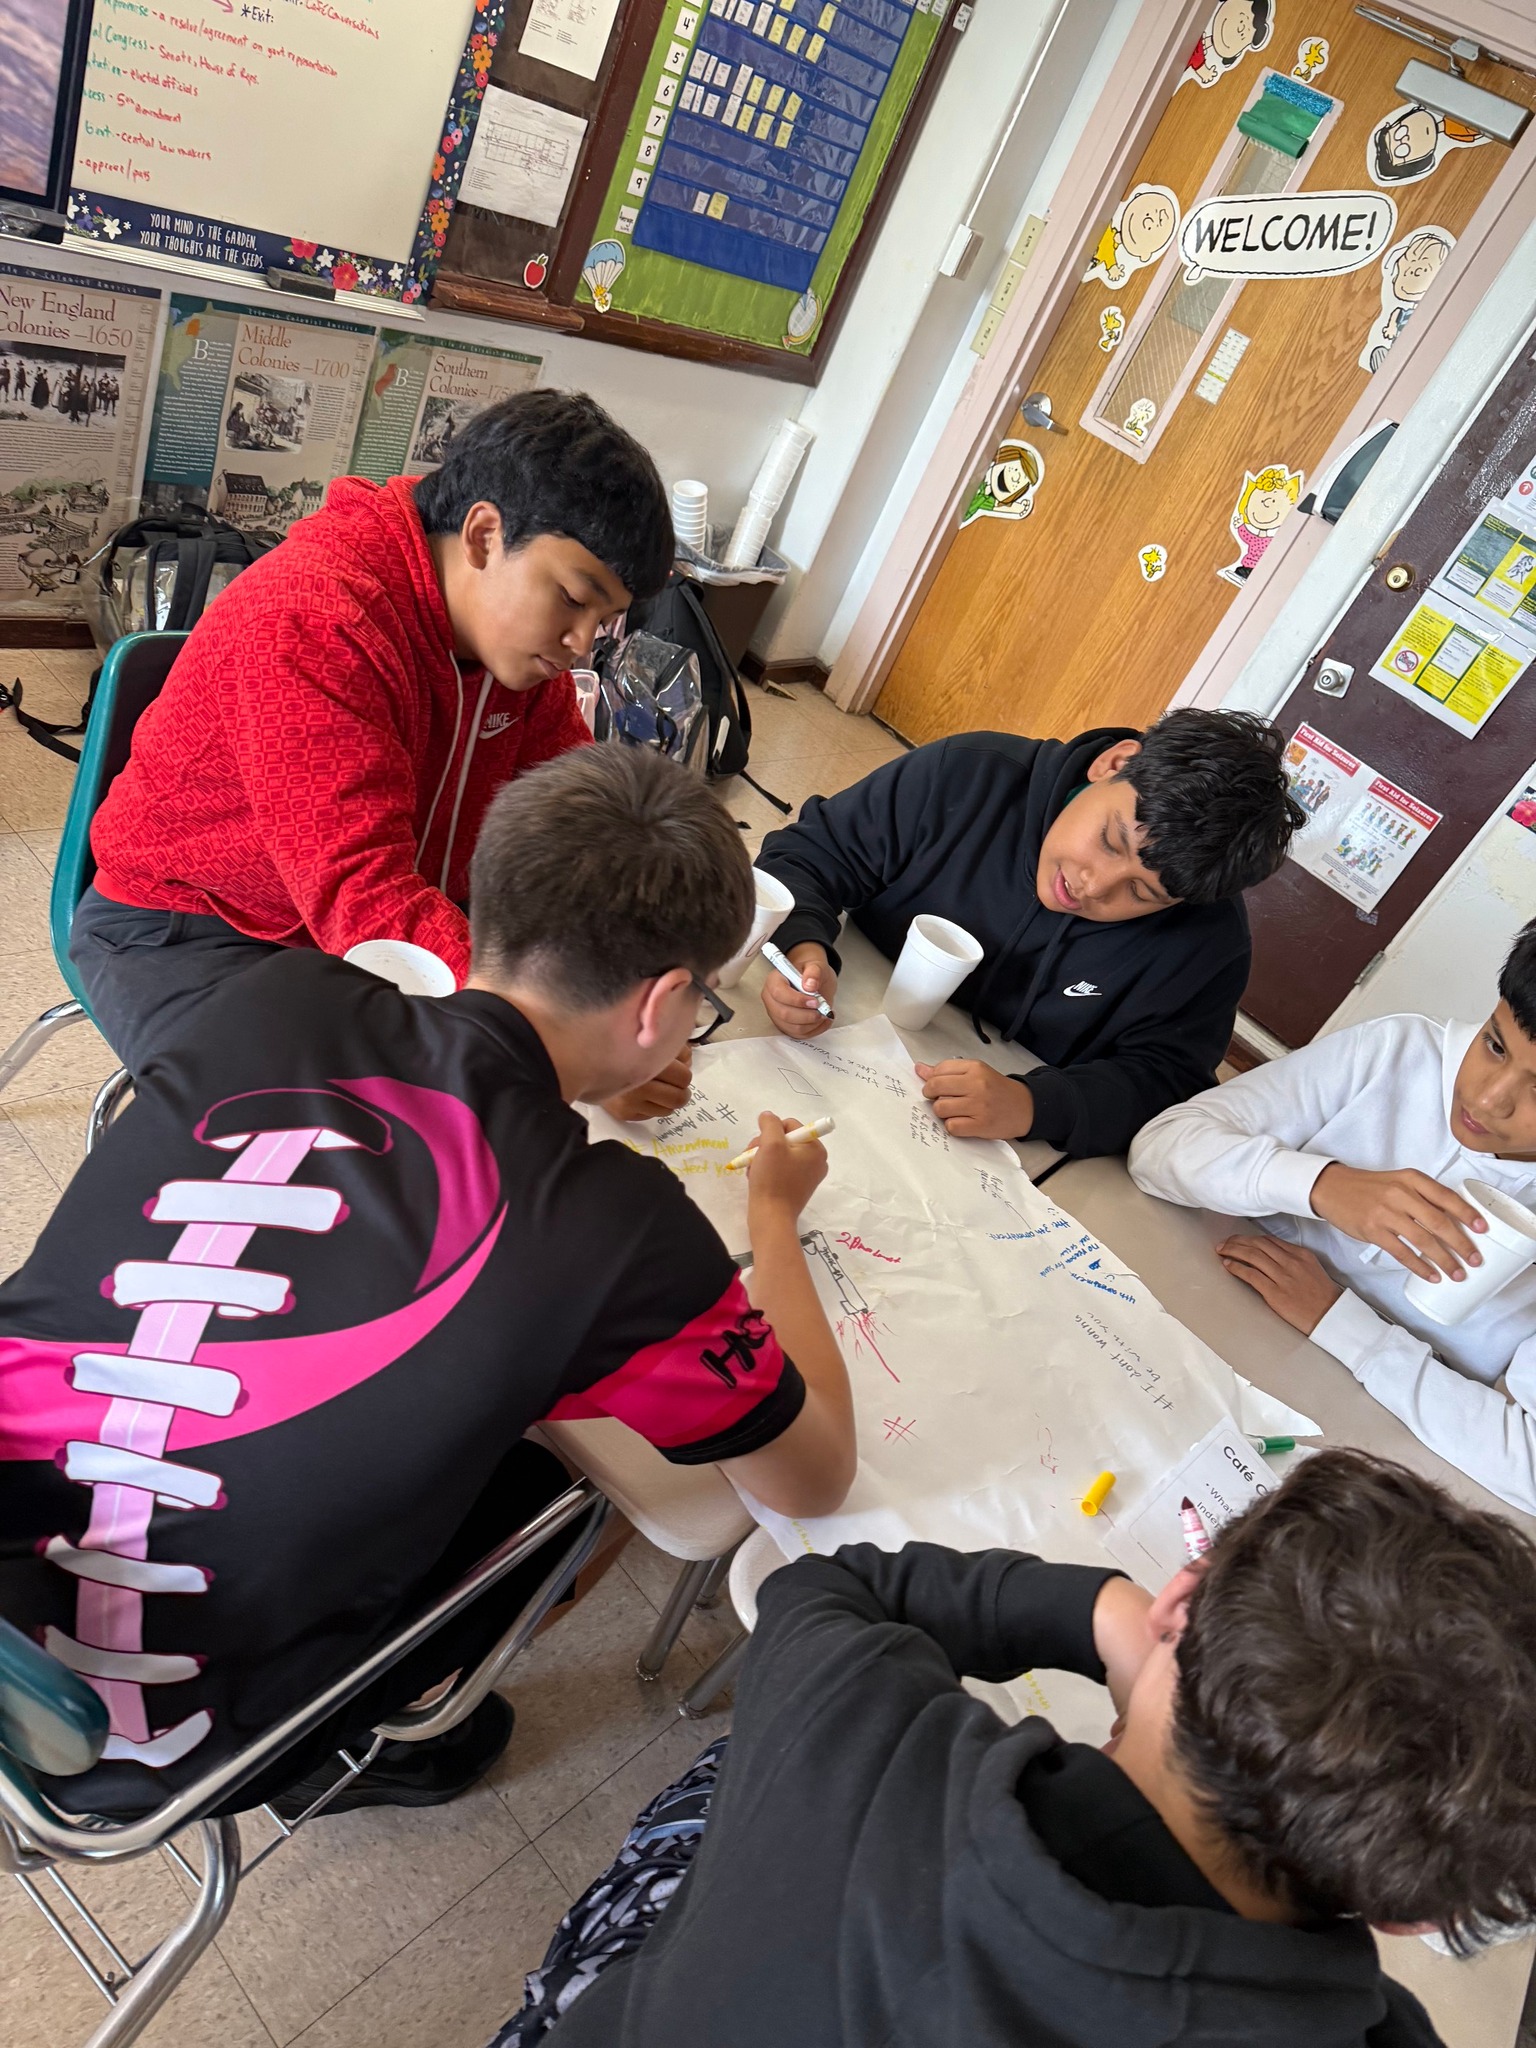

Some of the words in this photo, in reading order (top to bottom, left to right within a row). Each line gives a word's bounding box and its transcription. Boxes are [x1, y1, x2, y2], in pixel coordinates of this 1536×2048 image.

[150, 213, 172, 231] YOUR
[174, 217, 194, 236] MIND
[196, 222, 205, 238] IS
[208, 225, 222, 242] THE
[1195, 210, 1377, 254] WELCOME!
[140, 230, 161, 249] YOUR
[164, 235, 204, 258] THOUGHTS
[206, 244, 222, 261] ARE
[225, 248, 239, 264] THE
[0, 285, 35, 310] New
[41, 290, 116, 322] England
[0, 310, 70, 340] Colonies
[242, 324, 292, 349] Middle
[238, 347, 300, 373] Colonies
[434, 355, 489, 380] Southern
[430, 376, 479, 398] Colonies
[484, 711, 511, 729] NIKE
[1299, 728, 1315, 742] First
[1312, 736, 1325, 749] Aid
[1322, 742, 1334, 754] for
[1331, 749, 1358, 769] Seizures
[1374, 780, 1390, 794] First
[1388, 788, 1401, 801] Aid
[1398, 796, 1411, 808] for
[1408, 802, 1435, 823] Seizures
[1073, 980, 1099, 994] NIKE
[1086, 1311, 1109, 1334] you
[1112, 1334, 1141, 1362] with
[1145, 1366, 1161, 1382] be
[1223, 1445, 1256, 1483] Café
